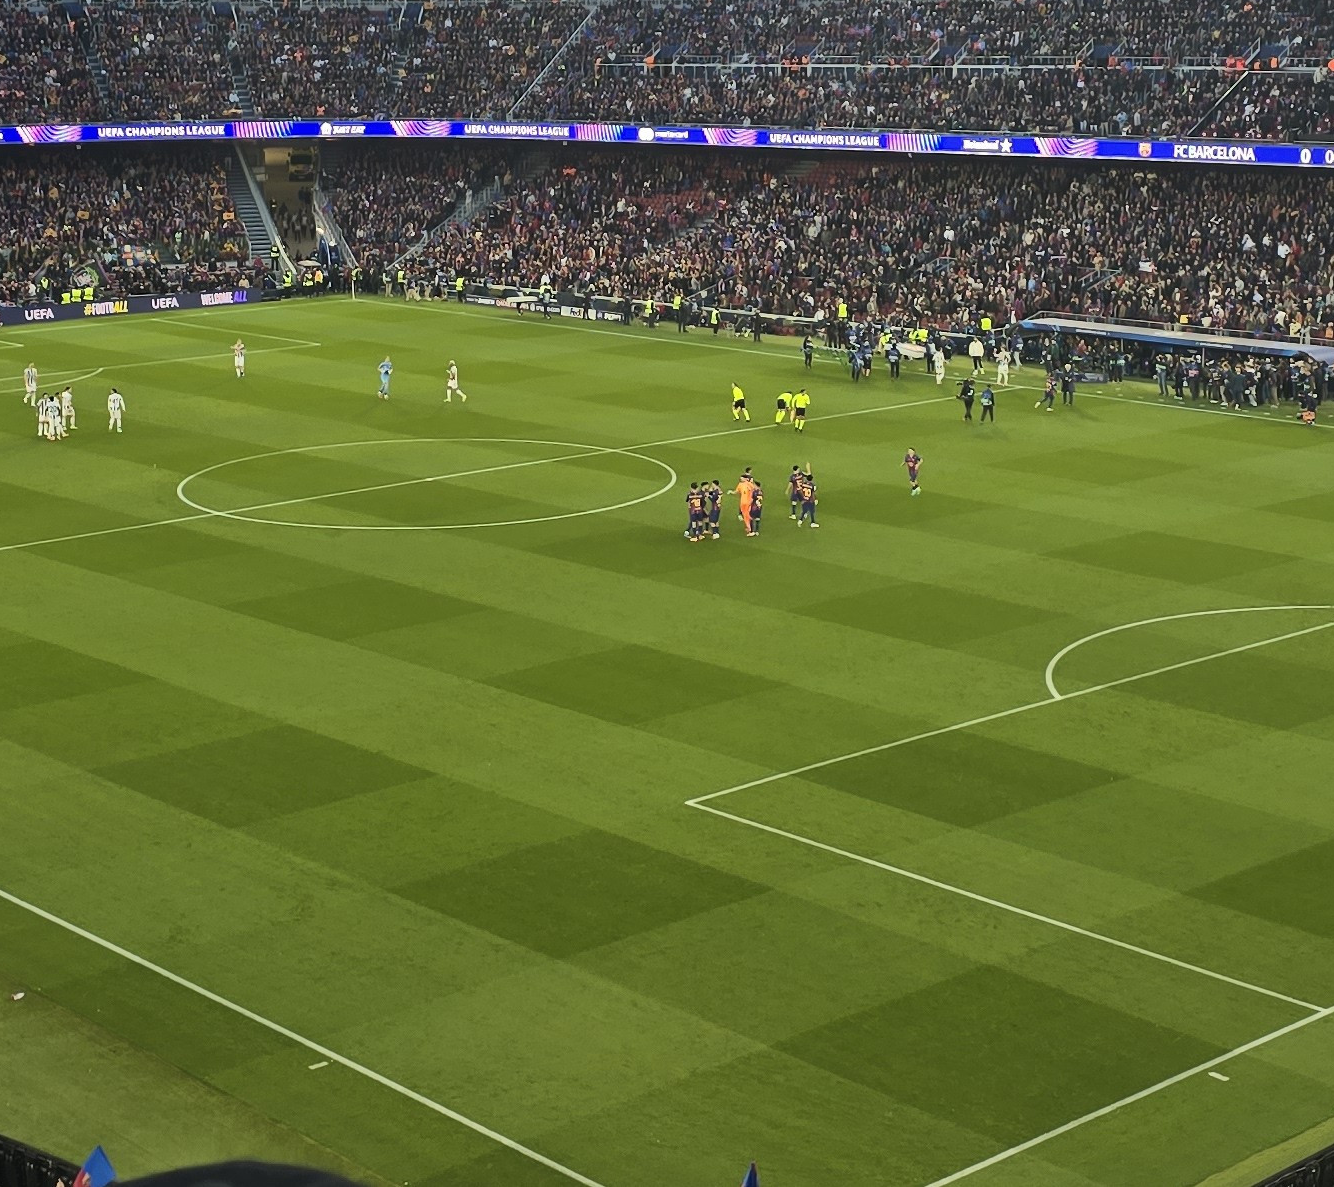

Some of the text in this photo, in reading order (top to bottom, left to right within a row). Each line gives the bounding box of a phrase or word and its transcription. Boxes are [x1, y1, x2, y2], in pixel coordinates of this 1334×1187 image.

[97, 125, 225, 137] UEFA CHAMPIONS LEAGUE
[464, 124, 569, 137] UEFA CHAMPIONS LEAGUE
[769, 133, 880, 147] UEFA CHAMPIONS LEAGUE
[1174, 144, 1188, 158] FC
[1188, 145, 1256, 162] BARCELONA
[1300, 148, 1312, 164] 0
[151, 296, 180, 310] UEFA
[200, 290, 248, 306] WELCOME ALL
[24, 307, 55, 321] UEFA
[84, 300, 128, 316] #FOOTBALL
